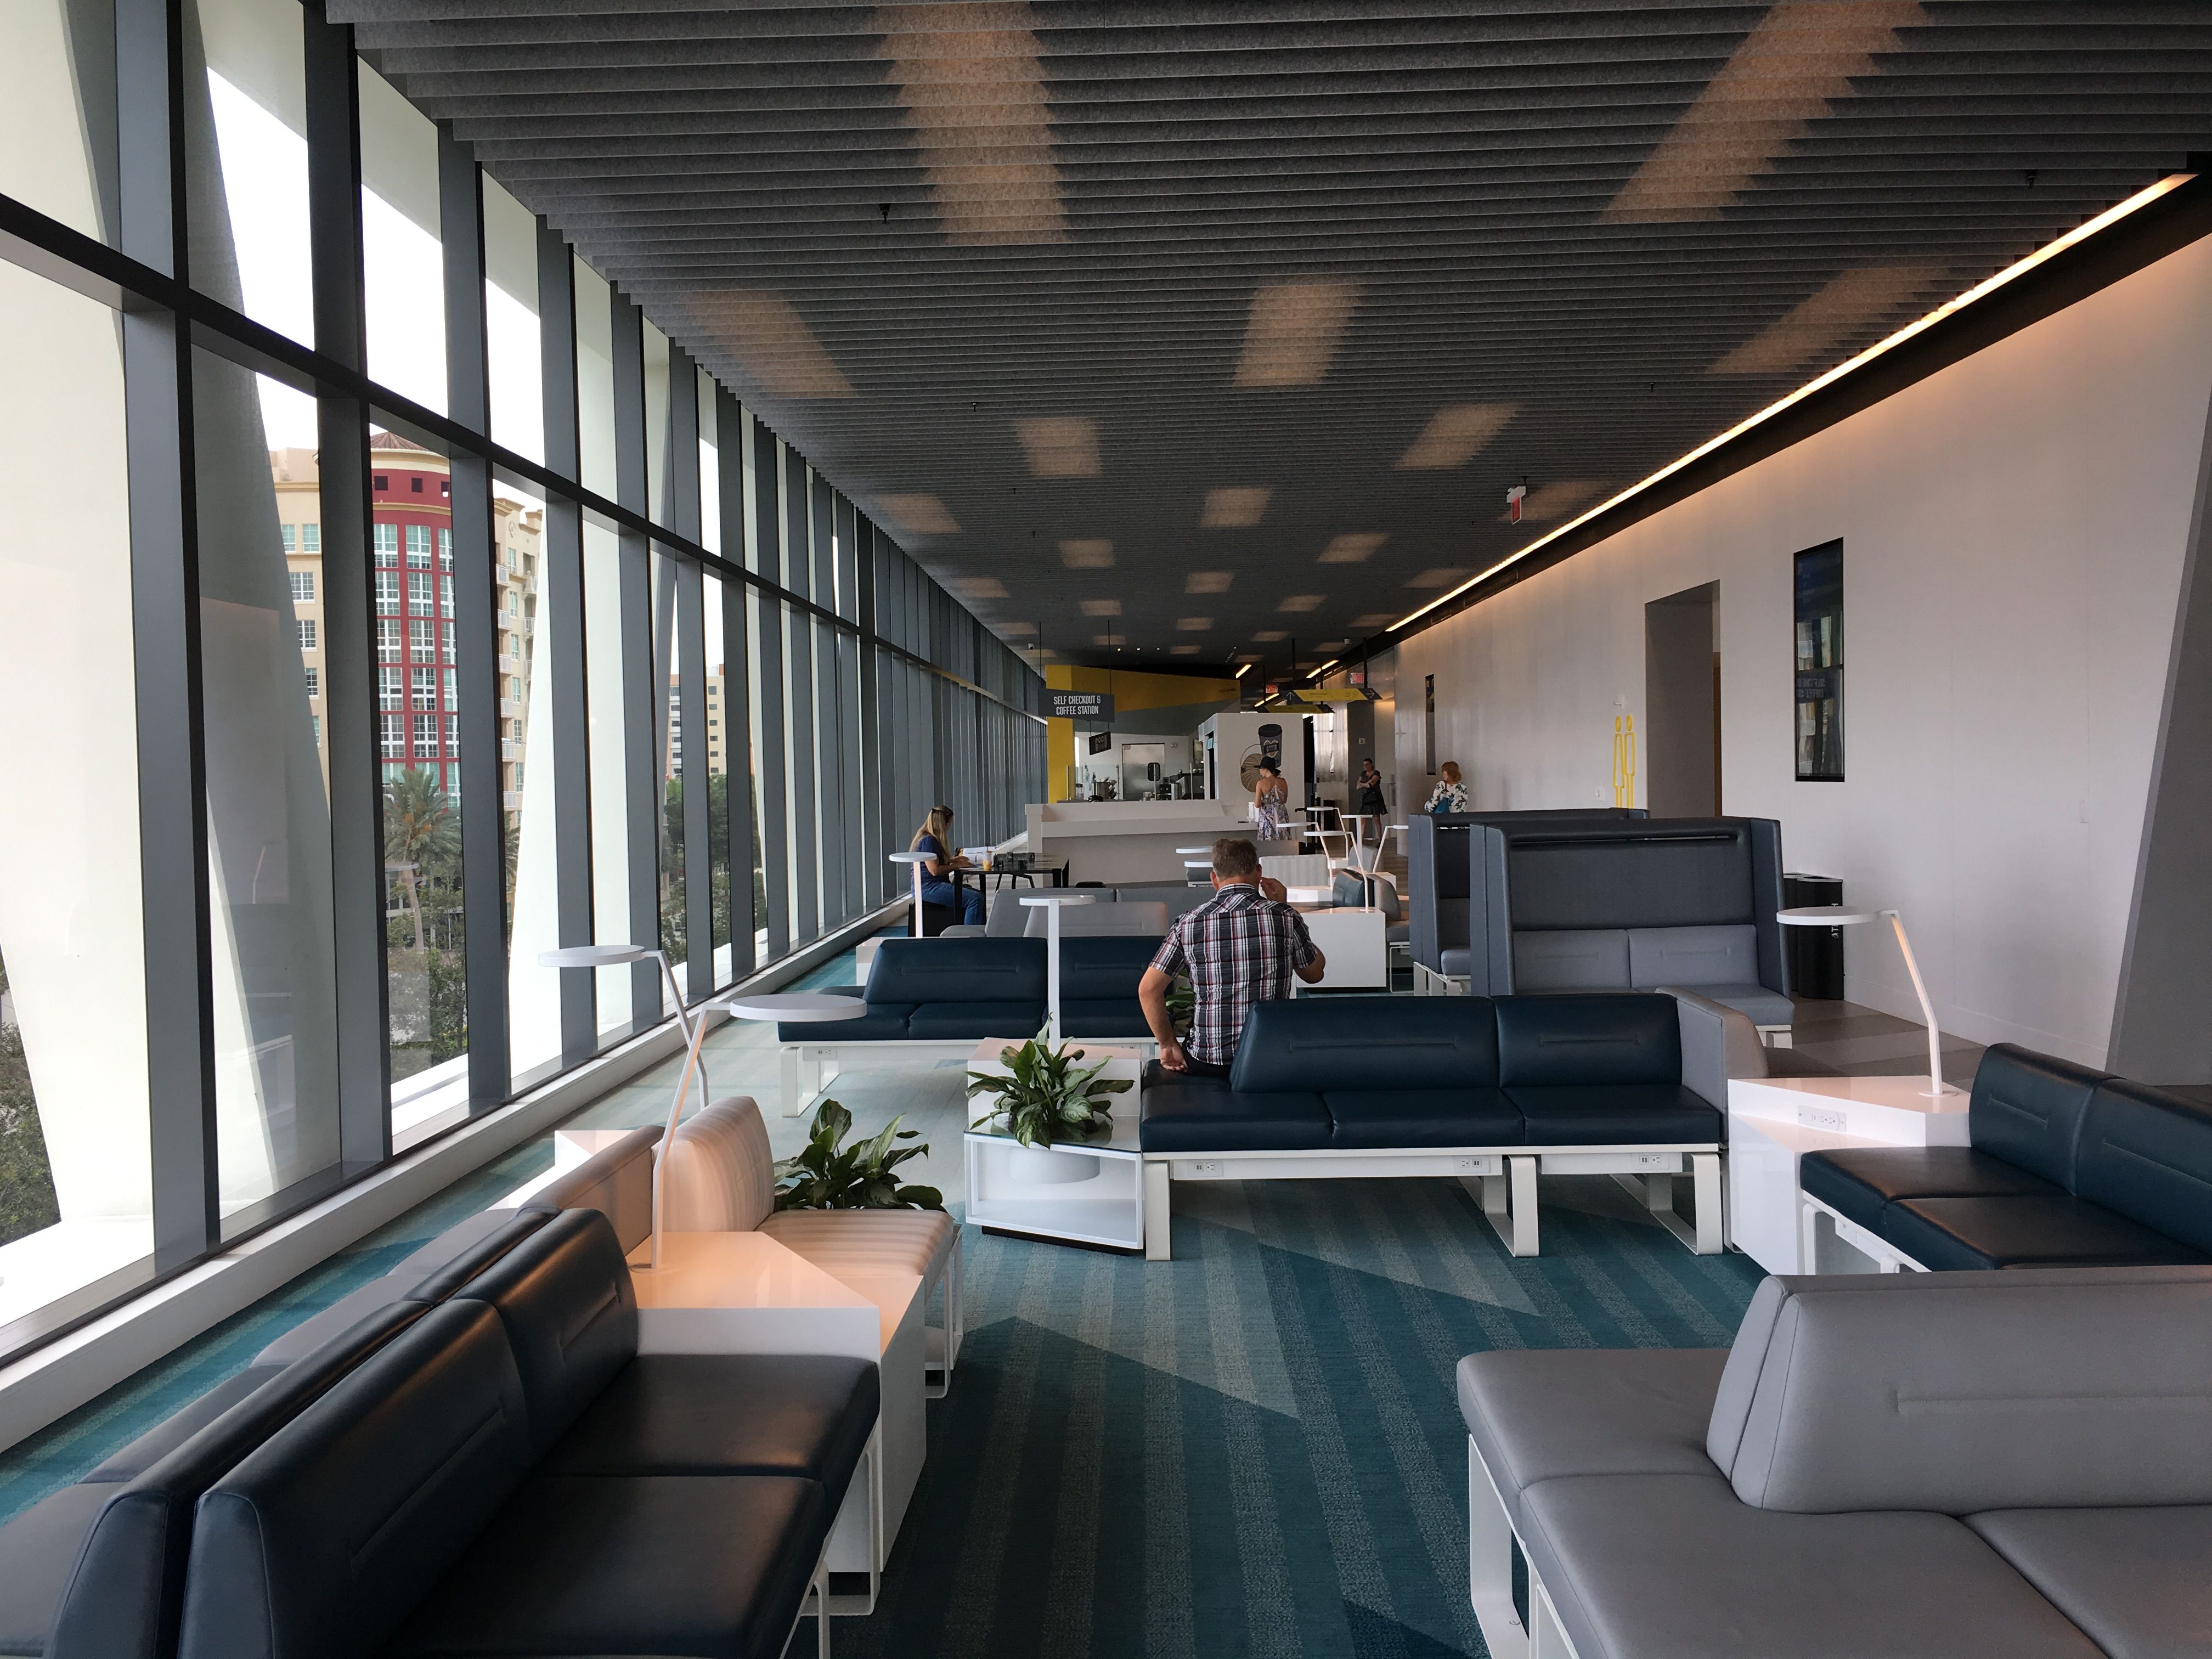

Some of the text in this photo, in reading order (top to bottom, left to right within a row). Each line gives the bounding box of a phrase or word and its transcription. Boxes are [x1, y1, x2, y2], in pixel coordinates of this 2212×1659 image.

[1053, 696, 1067, 705] SELF
[1068, 695, 1096, 704] CHECKOUT
[1056, 706, 1099, 715] COFFEE STATION
